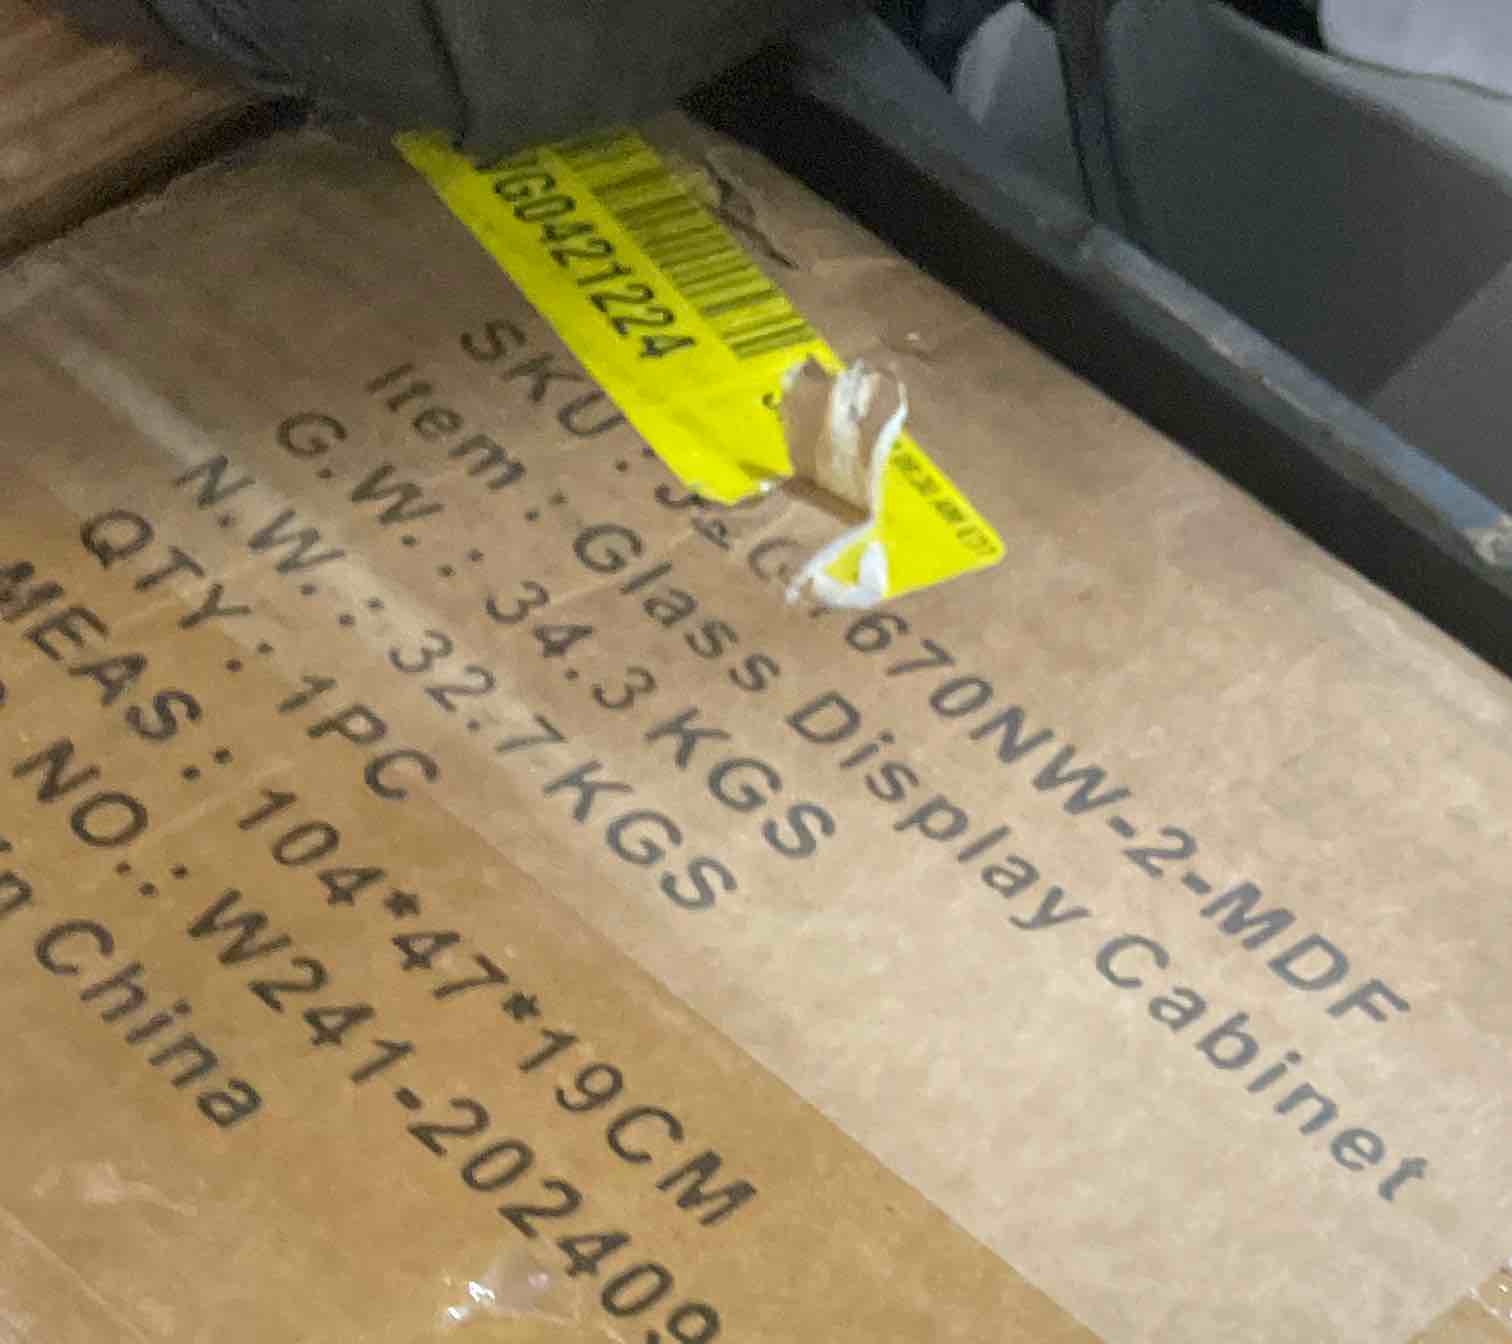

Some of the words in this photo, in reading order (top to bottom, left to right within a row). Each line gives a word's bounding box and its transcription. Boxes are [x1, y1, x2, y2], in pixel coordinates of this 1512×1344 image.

[460, 319, 655, 472] SKU:
[172, 455, 383, 626] N.W.:
[276, 411, 484, 576] G.W.:
[81, 509, 273, 672] QTY:
[278, 674, 439, 800] 1PC
[366, 363, 568, 522] Item:
[573, 523, 781, 692] Glass
[786, 691, 1090, 931] Display
[1095, 934, 1431, 1201] Cabinet
[35, 919, 262, 1128] China
